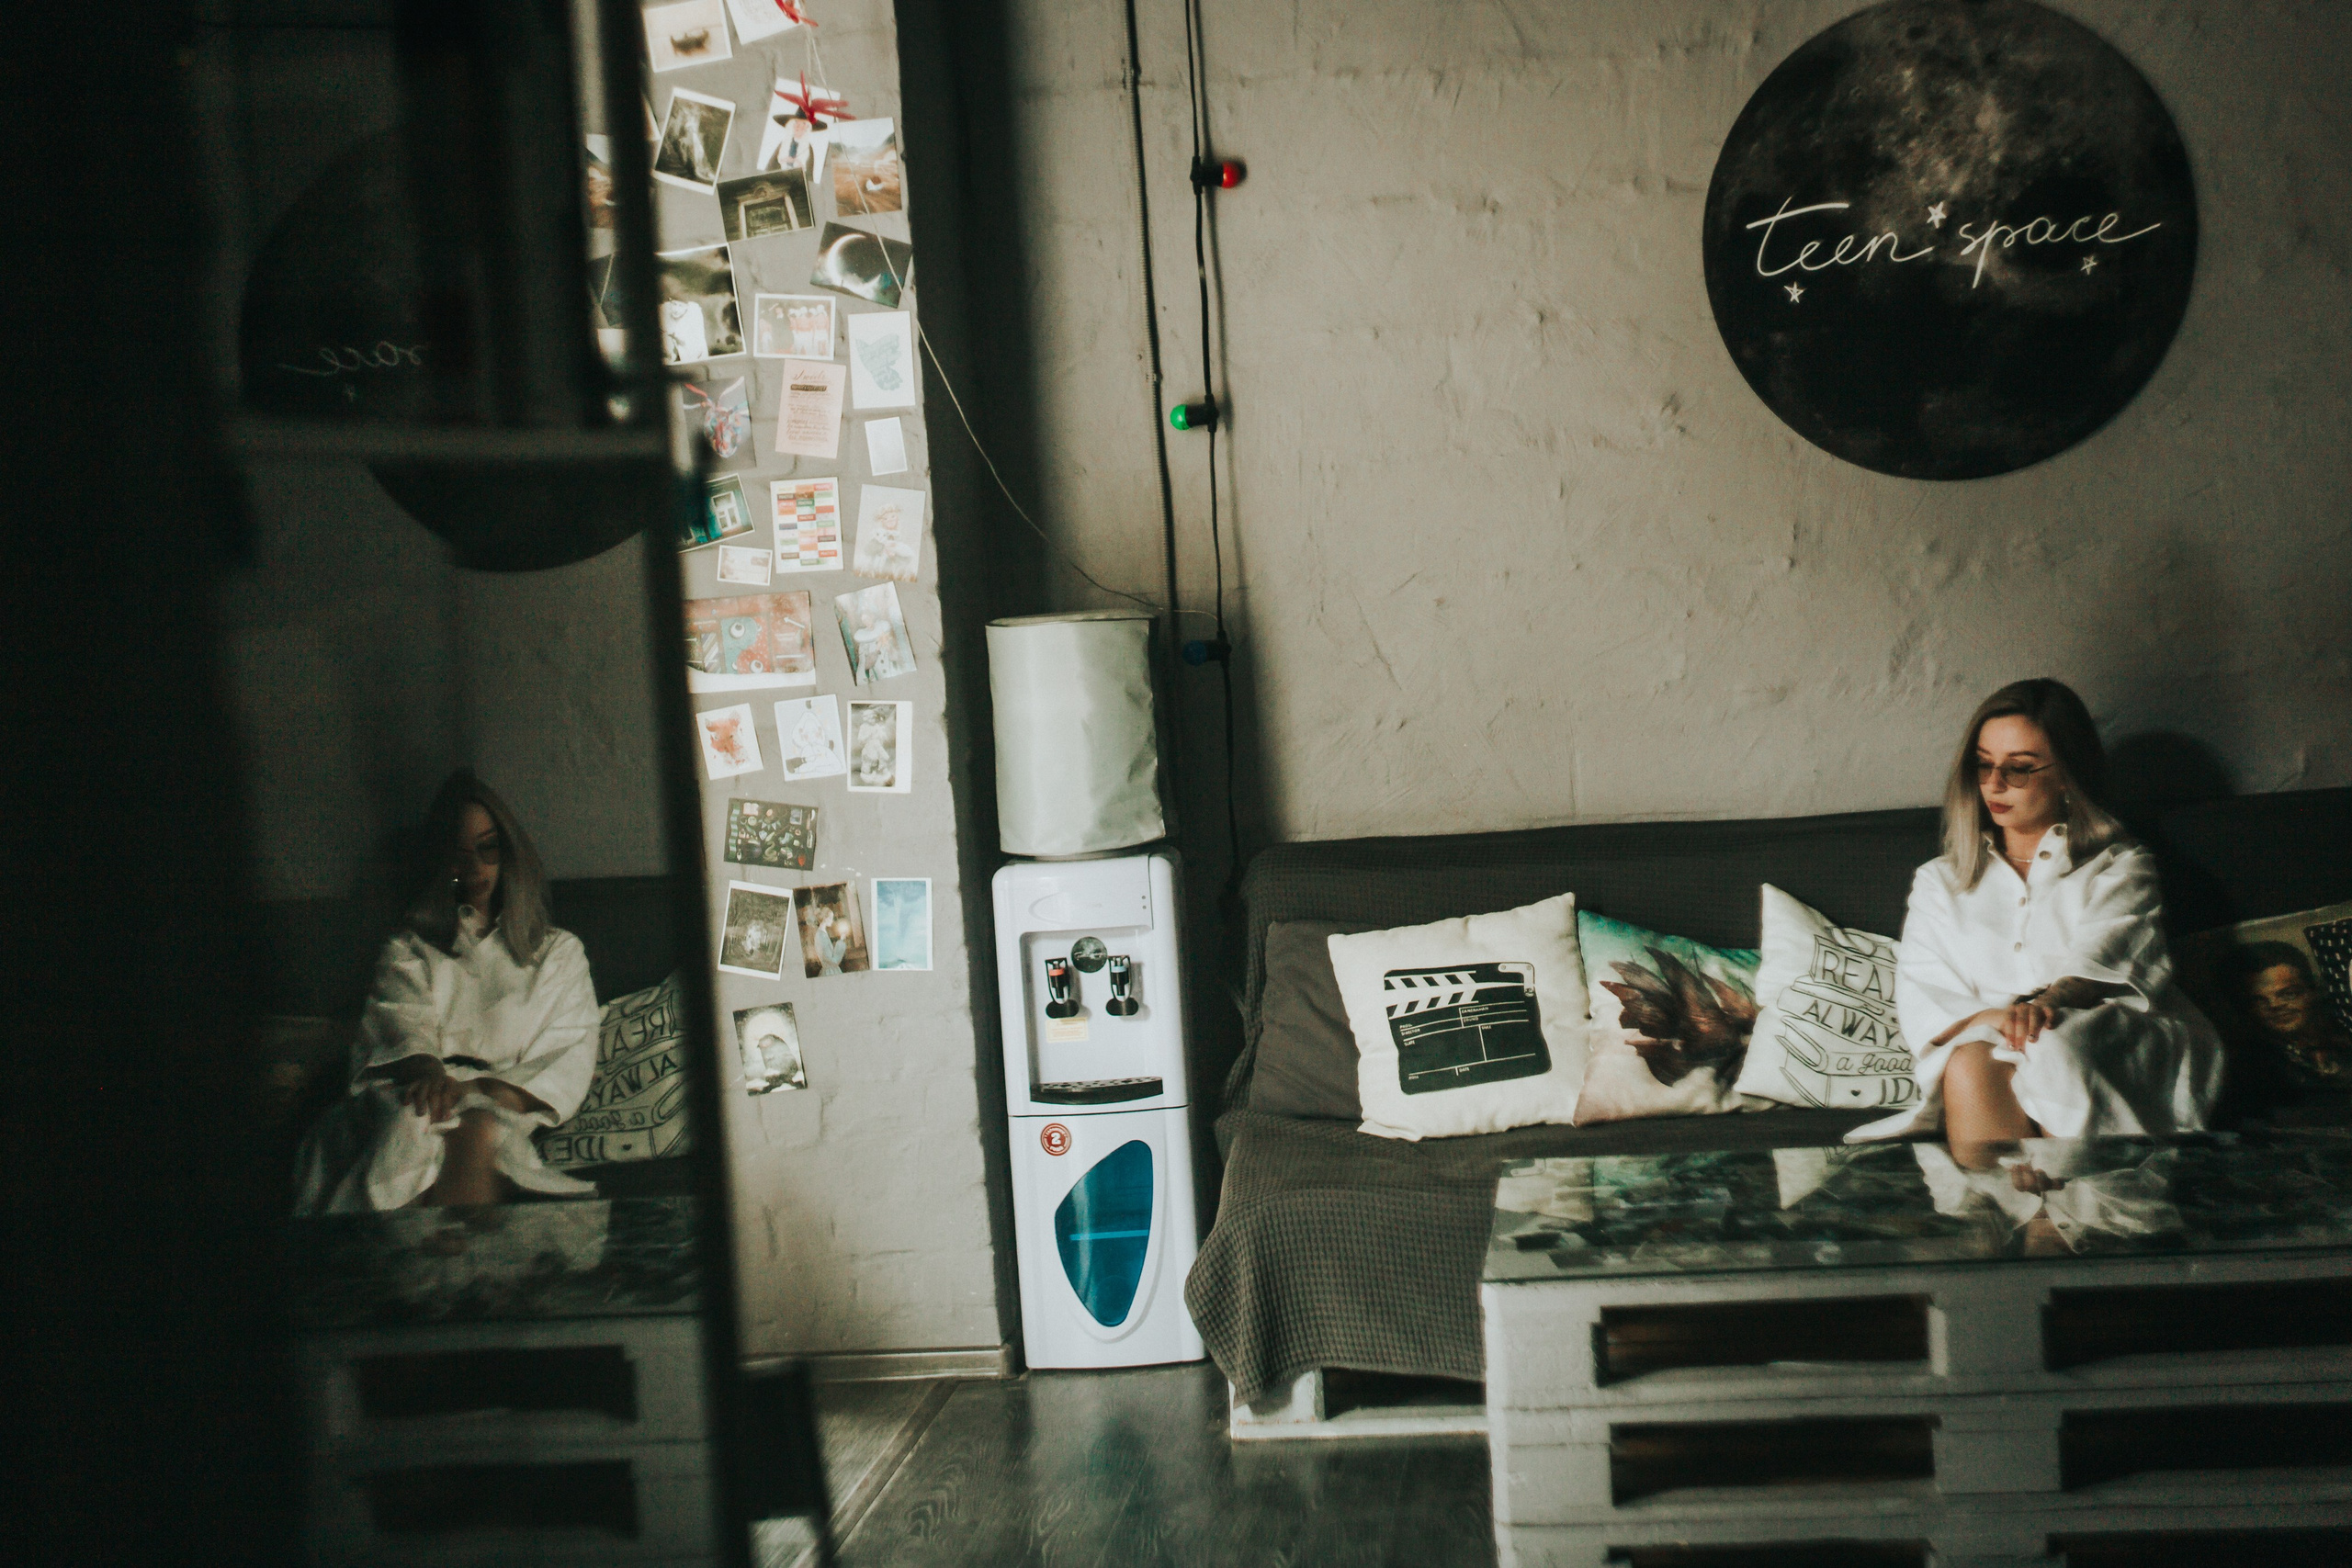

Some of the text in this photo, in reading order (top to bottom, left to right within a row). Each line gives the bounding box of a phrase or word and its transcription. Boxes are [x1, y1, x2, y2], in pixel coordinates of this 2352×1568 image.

[1746, 197, 2161, 289] teen space
[1836, 1056, 1854, 1071] a
[1050, 1132, 1062, 1145] 2
